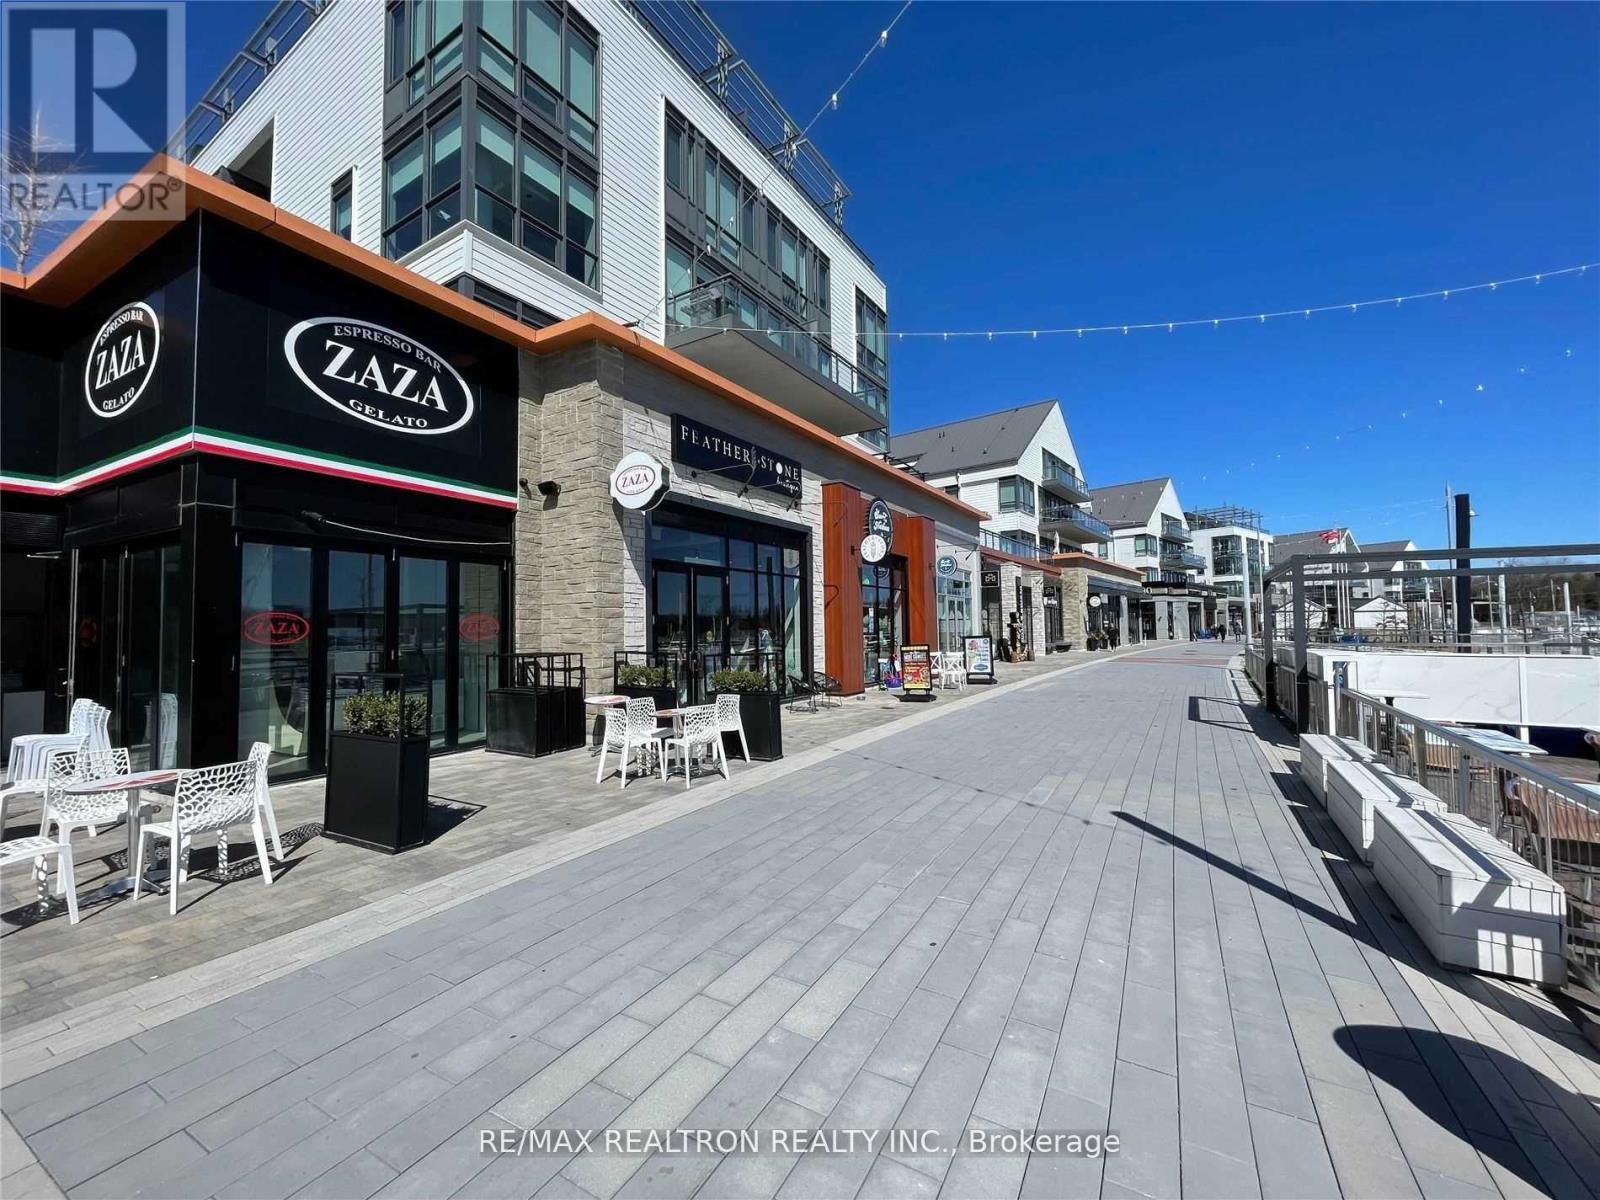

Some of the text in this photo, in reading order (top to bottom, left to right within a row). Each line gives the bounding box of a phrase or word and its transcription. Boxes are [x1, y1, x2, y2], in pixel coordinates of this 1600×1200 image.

[101, 310, 144, 346] ESPRESSO BAR
[95, 329, 146, 390] ZAZA
[334, 325, 442, 373] ESPRESSO BAR
[322, 339, 449, 413] ZAZA
[102, 387, 135, 410] GELATO
[349, 399, 428, 428] GELATO
[681, 424, 751, 463] FEATHER
[621, 473, 649, 488] ZAZA
[254, 622, 300, 635] ZAZA
